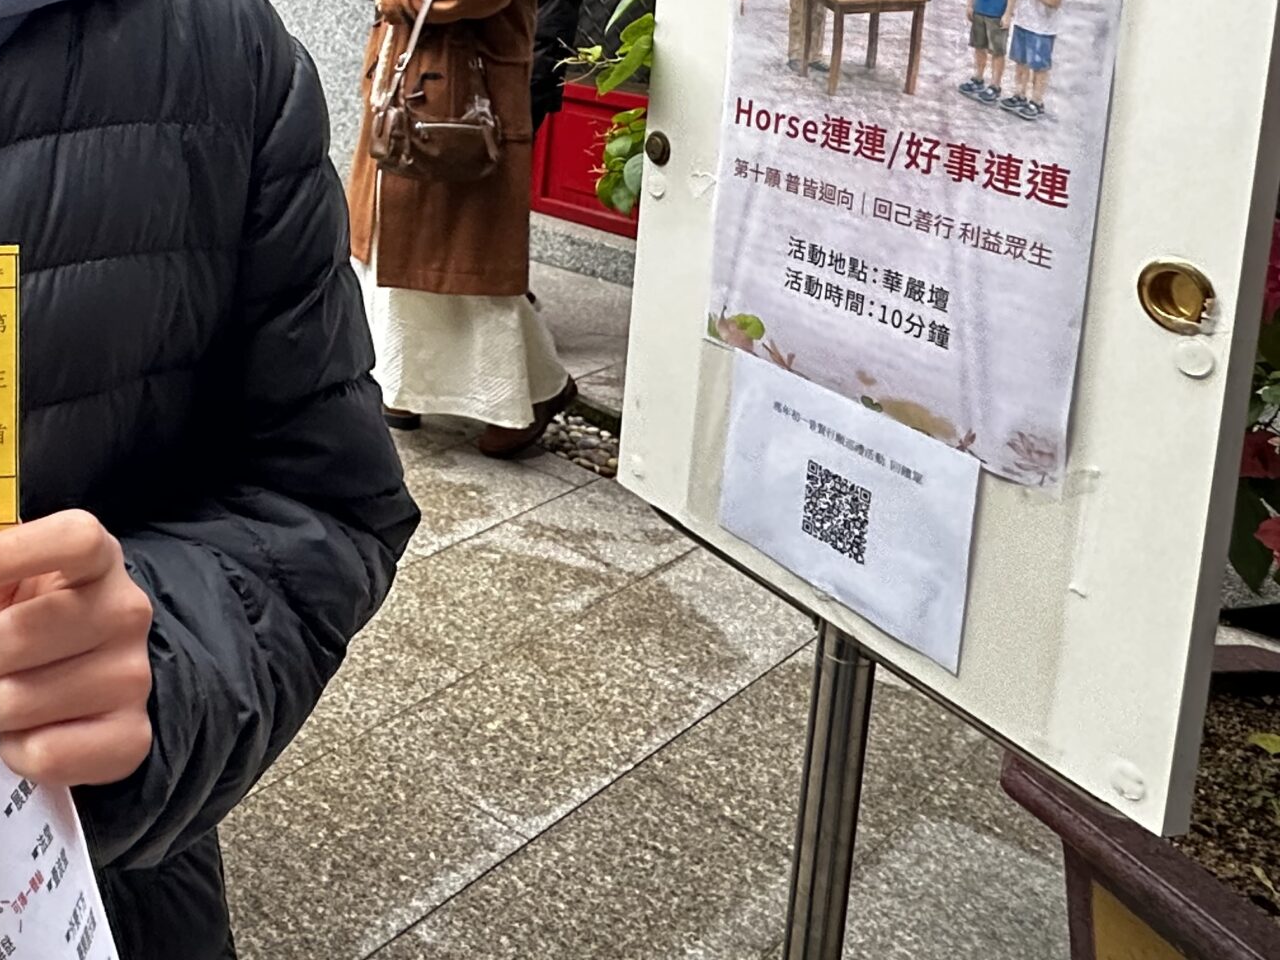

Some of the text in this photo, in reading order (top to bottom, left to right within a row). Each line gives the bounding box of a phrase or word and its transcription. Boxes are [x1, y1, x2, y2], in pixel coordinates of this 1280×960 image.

[734, 97, 1071, 209] Horse連連/好事連連
